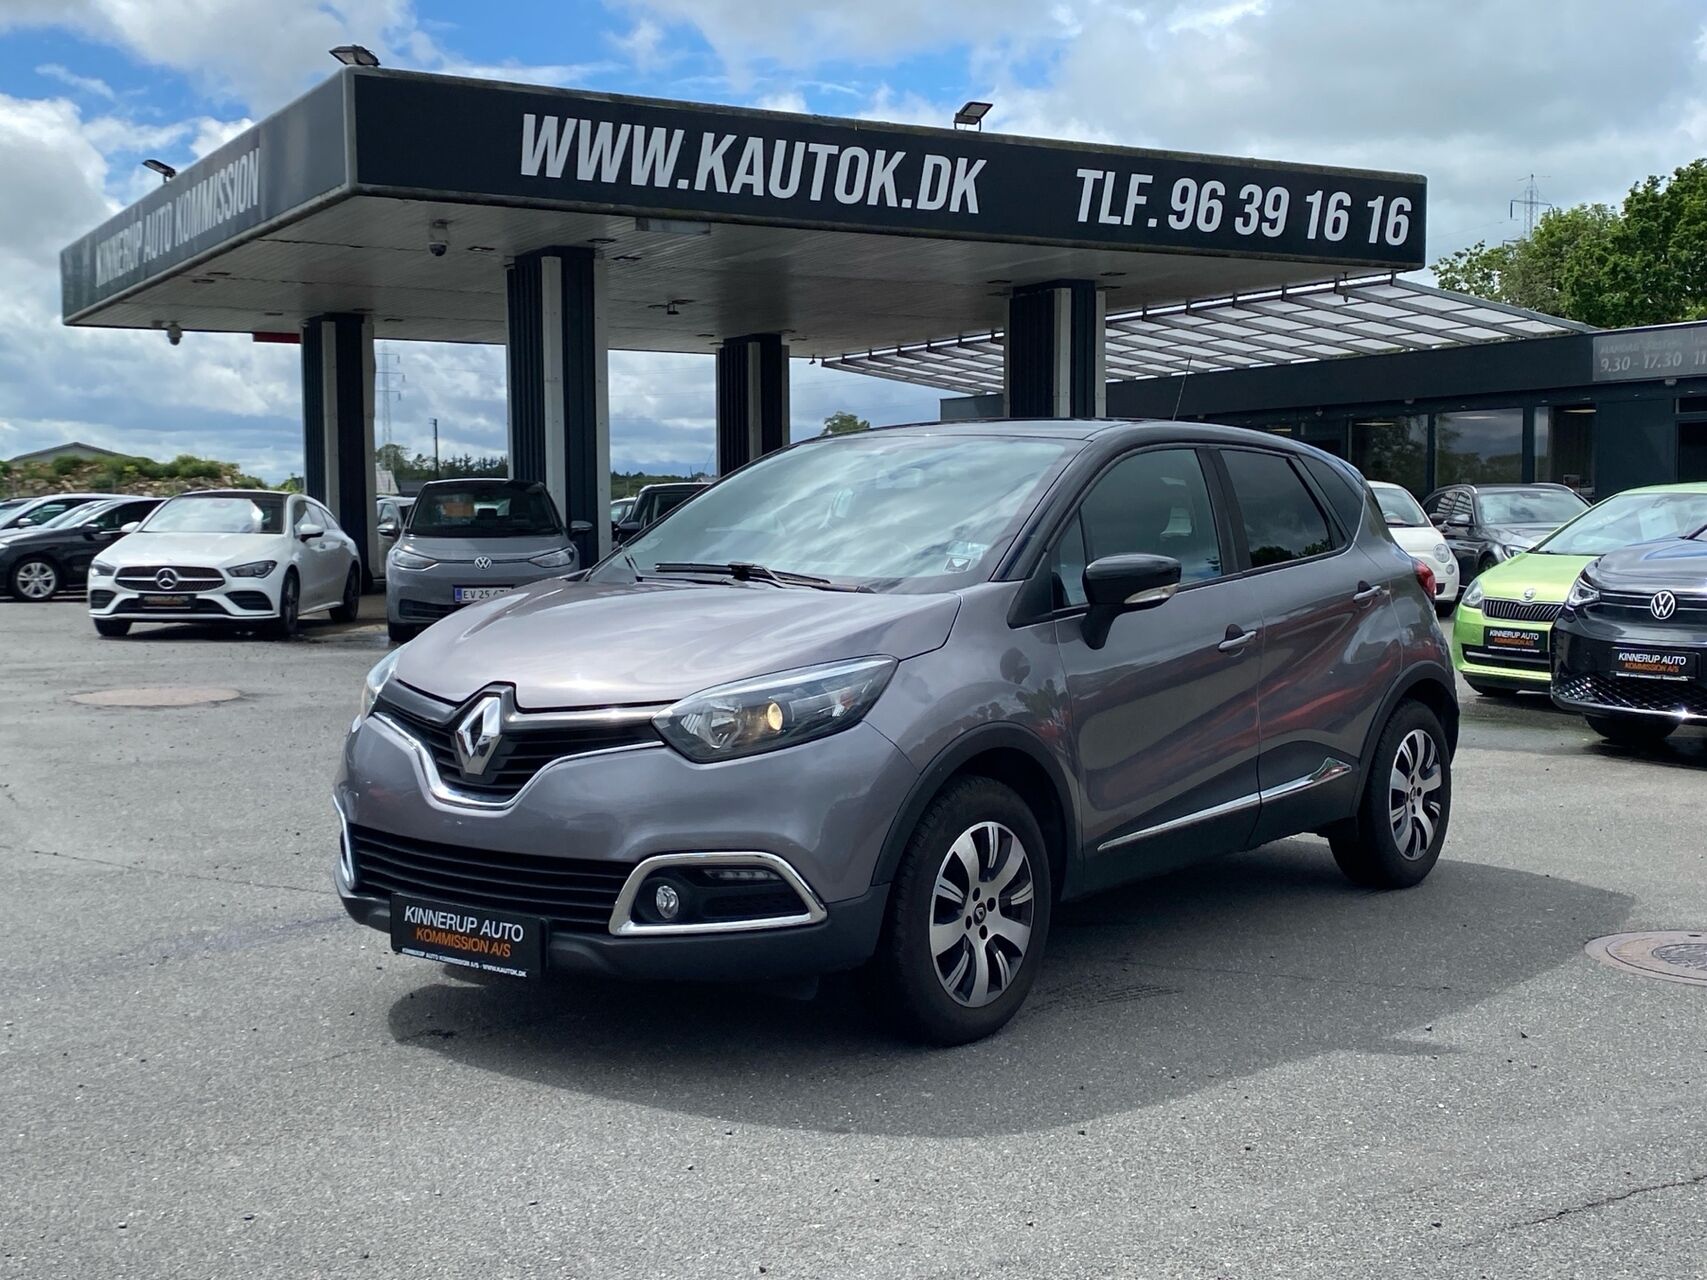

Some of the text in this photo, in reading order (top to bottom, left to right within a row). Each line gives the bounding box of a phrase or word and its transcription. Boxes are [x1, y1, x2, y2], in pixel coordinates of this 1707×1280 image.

[520, 113, 987, 214] WWW.KAUTOK.DK
[143, 202, 173, 263] AUTO
[175, 148, 260, 247] KOMMISSION
[1076, 168, 1412, 246] TLF. 96 39 16 16
[1600, 356, 1631, 373] 9.30
[1643, 351, 1683, 369] 17.30
[1521, 632, 1539, 640] AUTO
[1619, 652, 1686, 665] KINNERUP AUTO
[404, 905, 524, 942] KINNERUP AUTO
[416, 927, 489, 952] KOMMISSION
[490, 942, 511, 958] A/S
